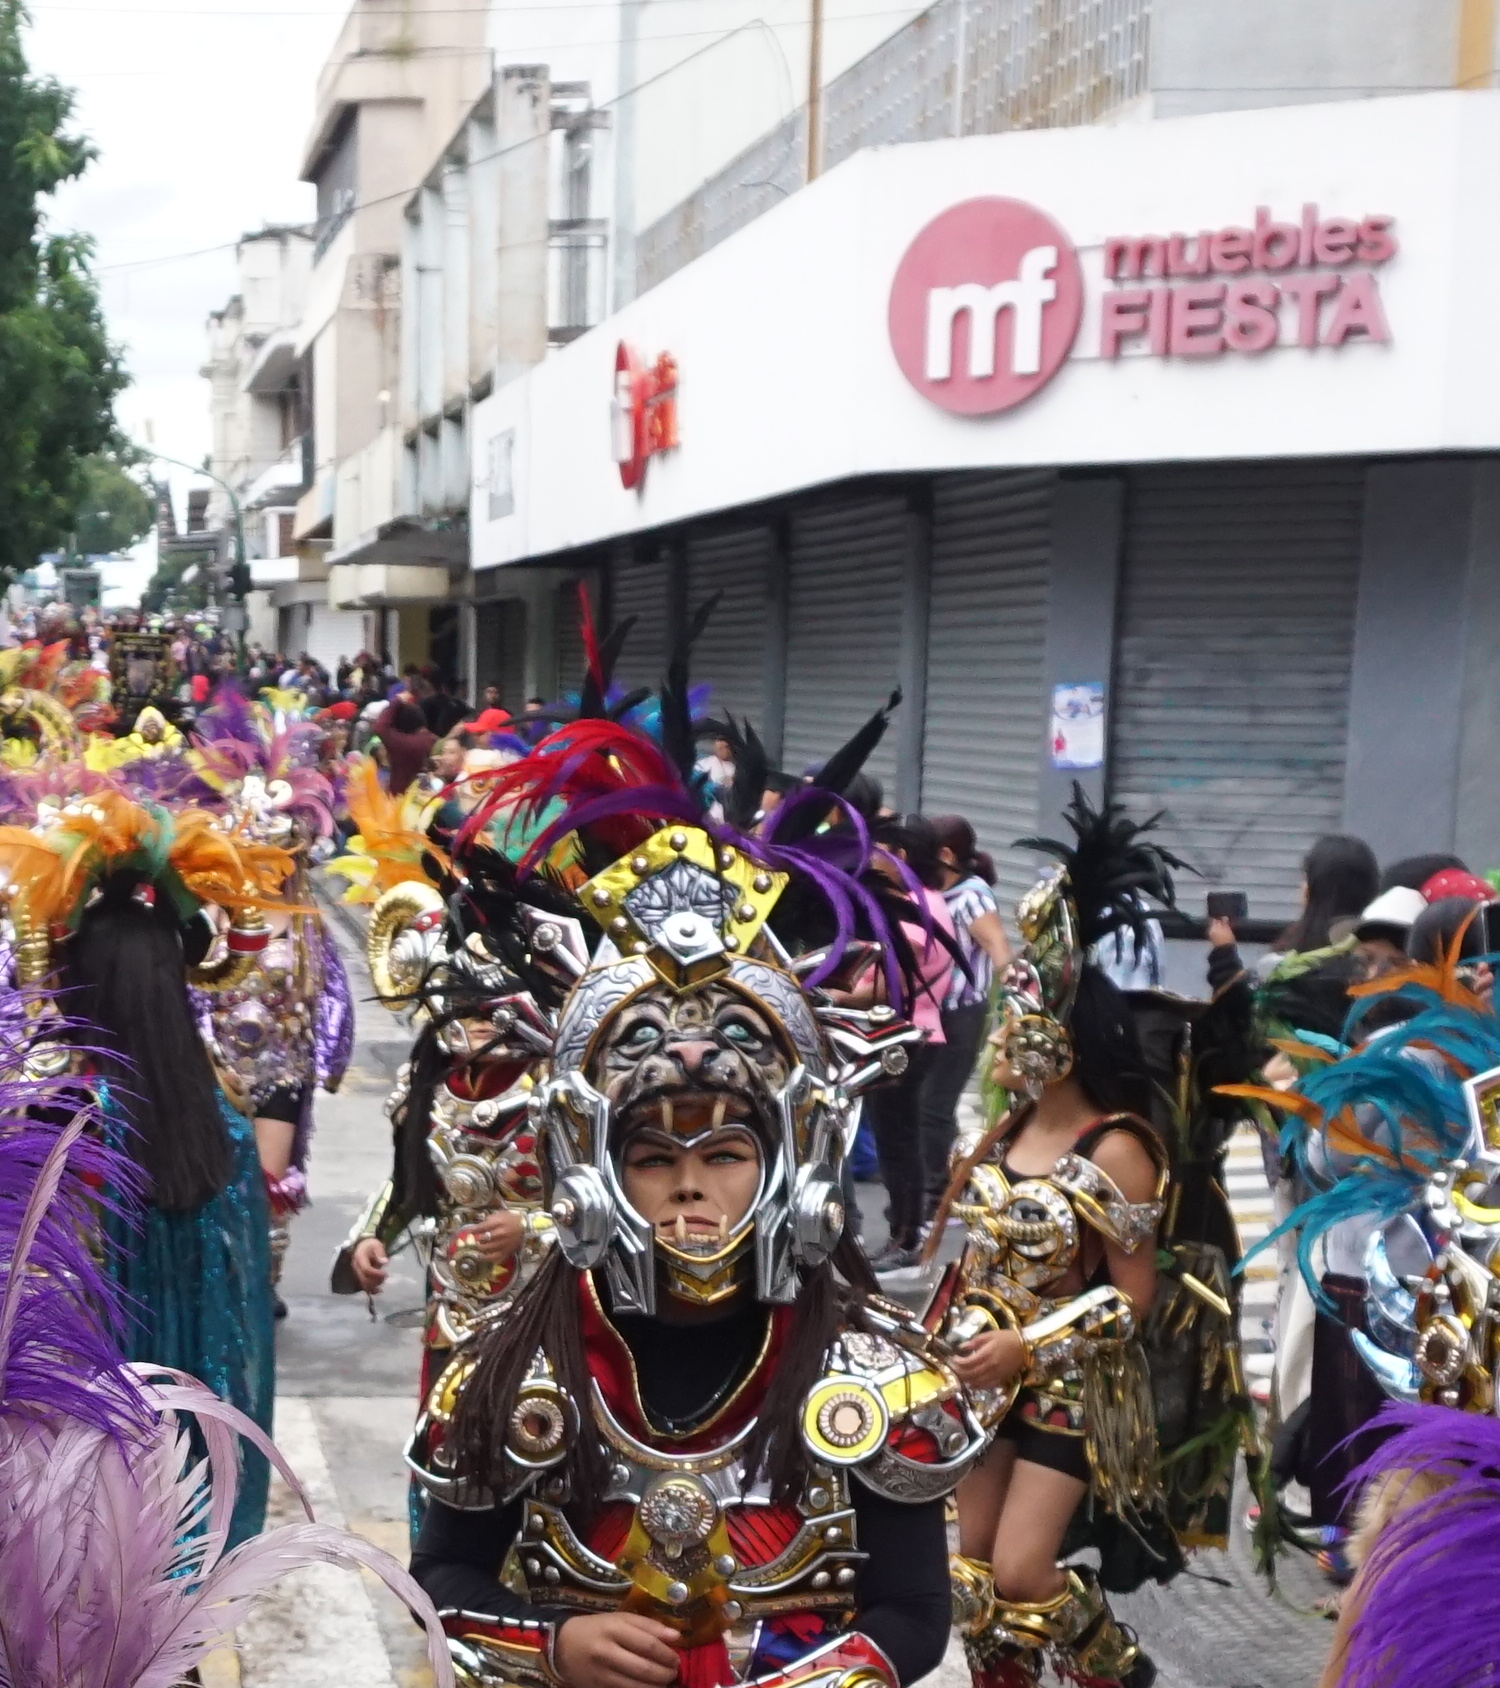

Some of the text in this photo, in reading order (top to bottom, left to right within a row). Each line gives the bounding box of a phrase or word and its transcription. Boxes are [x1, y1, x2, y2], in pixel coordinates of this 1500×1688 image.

[1102, 202, 1398, 280] muebles
[924, 244, 1058, 383] mf
[1099, 272, 1394, 362] FIESTA
